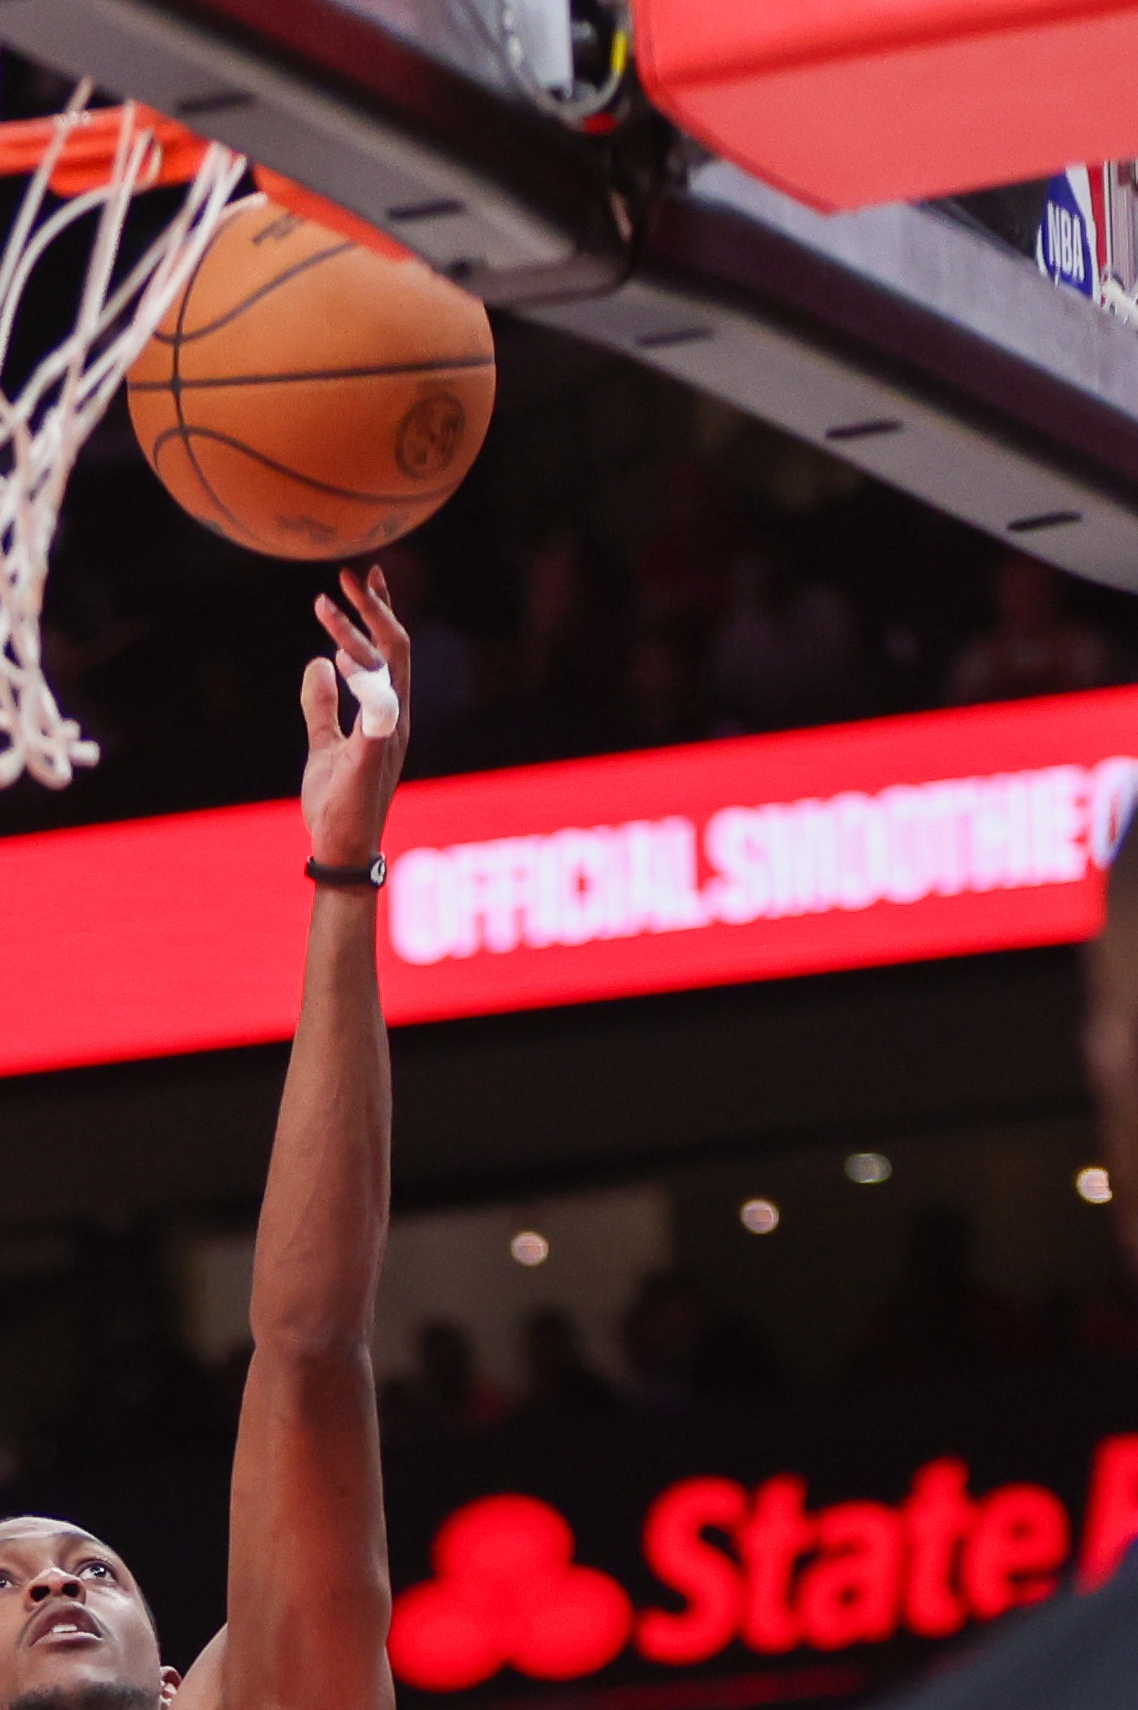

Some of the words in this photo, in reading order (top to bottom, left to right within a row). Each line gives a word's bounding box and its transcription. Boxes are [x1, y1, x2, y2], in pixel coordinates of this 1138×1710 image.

[1047, 200, 1084, 281] NBA
[389, 817, 706, 965] OFFICIAL
[704, 764, 1088, 926] SMOOTHIE
[638, 1456, 1069, 1663] State
